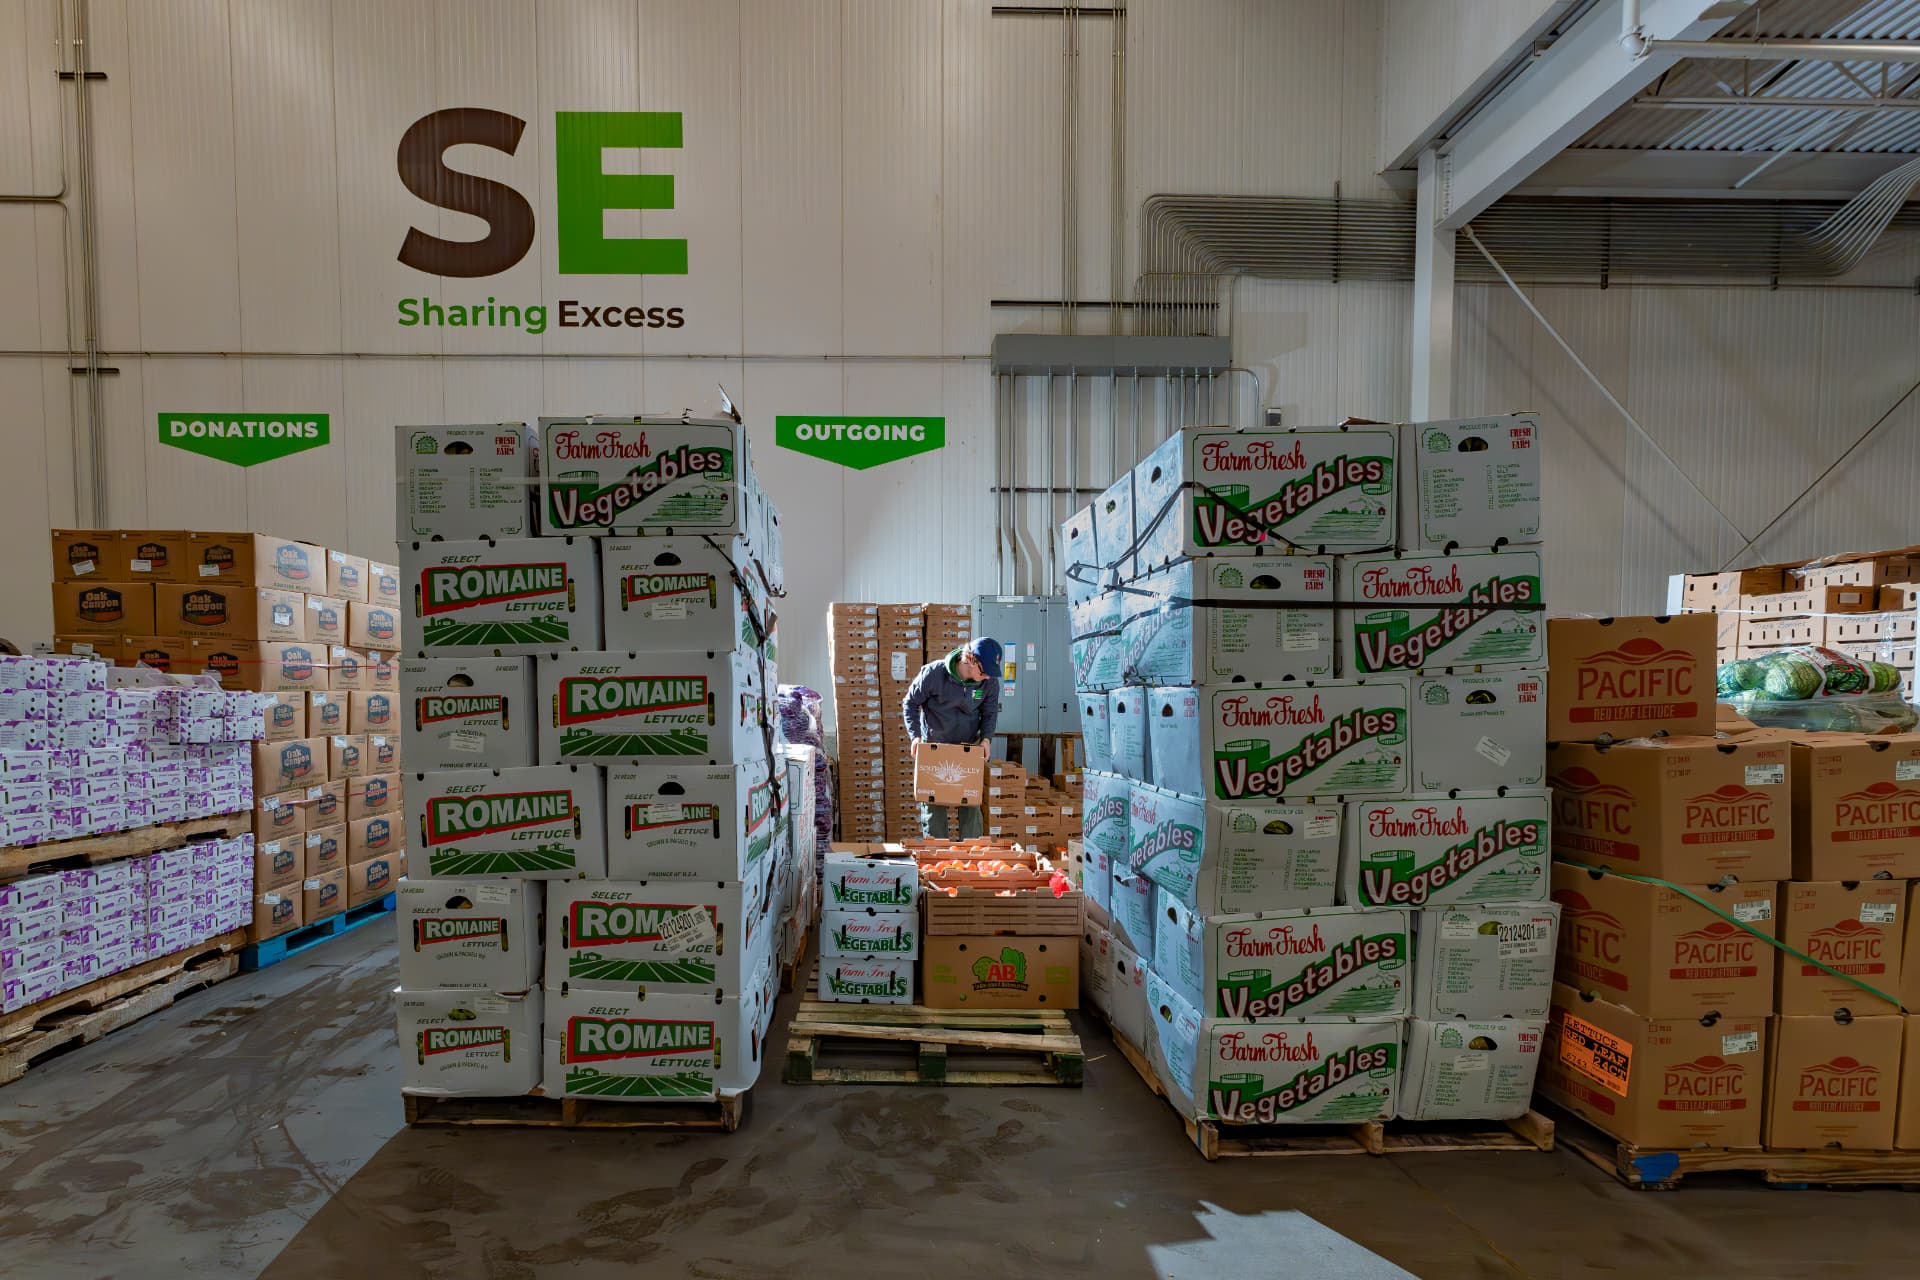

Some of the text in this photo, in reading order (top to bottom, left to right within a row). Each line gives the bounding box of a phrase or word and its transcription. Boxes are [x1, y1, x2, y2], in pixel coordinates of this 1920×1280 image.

[397, 108, 688, 278] SE
[398, 297, 685, 334] Sharing Excess
[170, 421, 318, 438] DONATIONS
[796, 424, 925, 441] OUTGOING
[555, 431, 651, 459] Farm Fresh
[1202, 440, 1306, 471] Farm Fresh
[551, 448, 724, 527] Vegetables
[1197, 456, 1384, 545] Vegetables
[440, 555, 482, 564] SELECT
[433, 568, 563, 603] ROMAINE
[634, 576, 707, 595] ROMAINE
[1362, 564, 1463, 598] Farm Fresh
[82, 599, 119, 609] Canyon
[86, 592, 108, 601] Oak
[186, 602, 223, 612] Canyon
[189, 594, 211, 603] Oak
[505, 601, 566, 612] LETTUCE
[1357, 577, 1533, 672] Vegetables
[580, 666, 621, 674] SELECT
[1577, 667, 1693, 700] PACIFIC
[428, 698, 499, 716] ROMAINE
[571, 681, 703, 713] ROMAINE
[643, 714, 705, 723] LETTUCE
[1221, 696, 1273, 727] Farm
[1266, 694, 1325, 725] Fresh
[1593, 704, 1675, 721] RED LEAF LETTUCE
[1217, 710, 1398, 798] Vegetables
[445, 784, 486, 793] SELECT
[438, 796, 569, 833] ROMAINE
[638, 807, 711, 825] RAINE
[1368, 806, 1469, 837] Farm Fresh
[1685, 804, 1771, 829] PACIFIC
[1835, 800, 1920, 827] PACIFIC
[510, 829, 572, 841] LETTUCE
[1363, 821, 1539, 906] Vegetables
[591, 891, 632, 900] SELECT
[426, 920, 499, 938] ROMAINE
[658, 912, 696, 940] 22124201
[1498, 923, 1536, 942] 22124201
[1226, 924, 1325, 957] Farm Fresh
[1807, 938, 1881, 960] PACIFIC
[1674, 941, 1754, 965] PACIFIC
[987, 964, 1017, 981] AB
[1218, 937, 1397, 1017] Vegetables
[588, 1006, 630, 1016] SELECT
[430, 1029, 502, 1049] ROMAINE
[579, 1023, 711, 1052] ROMAINE
[1565, 1016, 1618, 1050] LETTUCE
[1219, 1032, 1319, 1062] Farm Fresh
[1565, 1029, 1627, 1067] RED LEAF
[651, 1057, 712, 1067] LETTUCE
[1212, 1046, 1389, 1124] Vegetables
[1664, 1072, 1743, 1096] PACIFIC
[1798, 1074, 1878, 1096] PACIFIC
